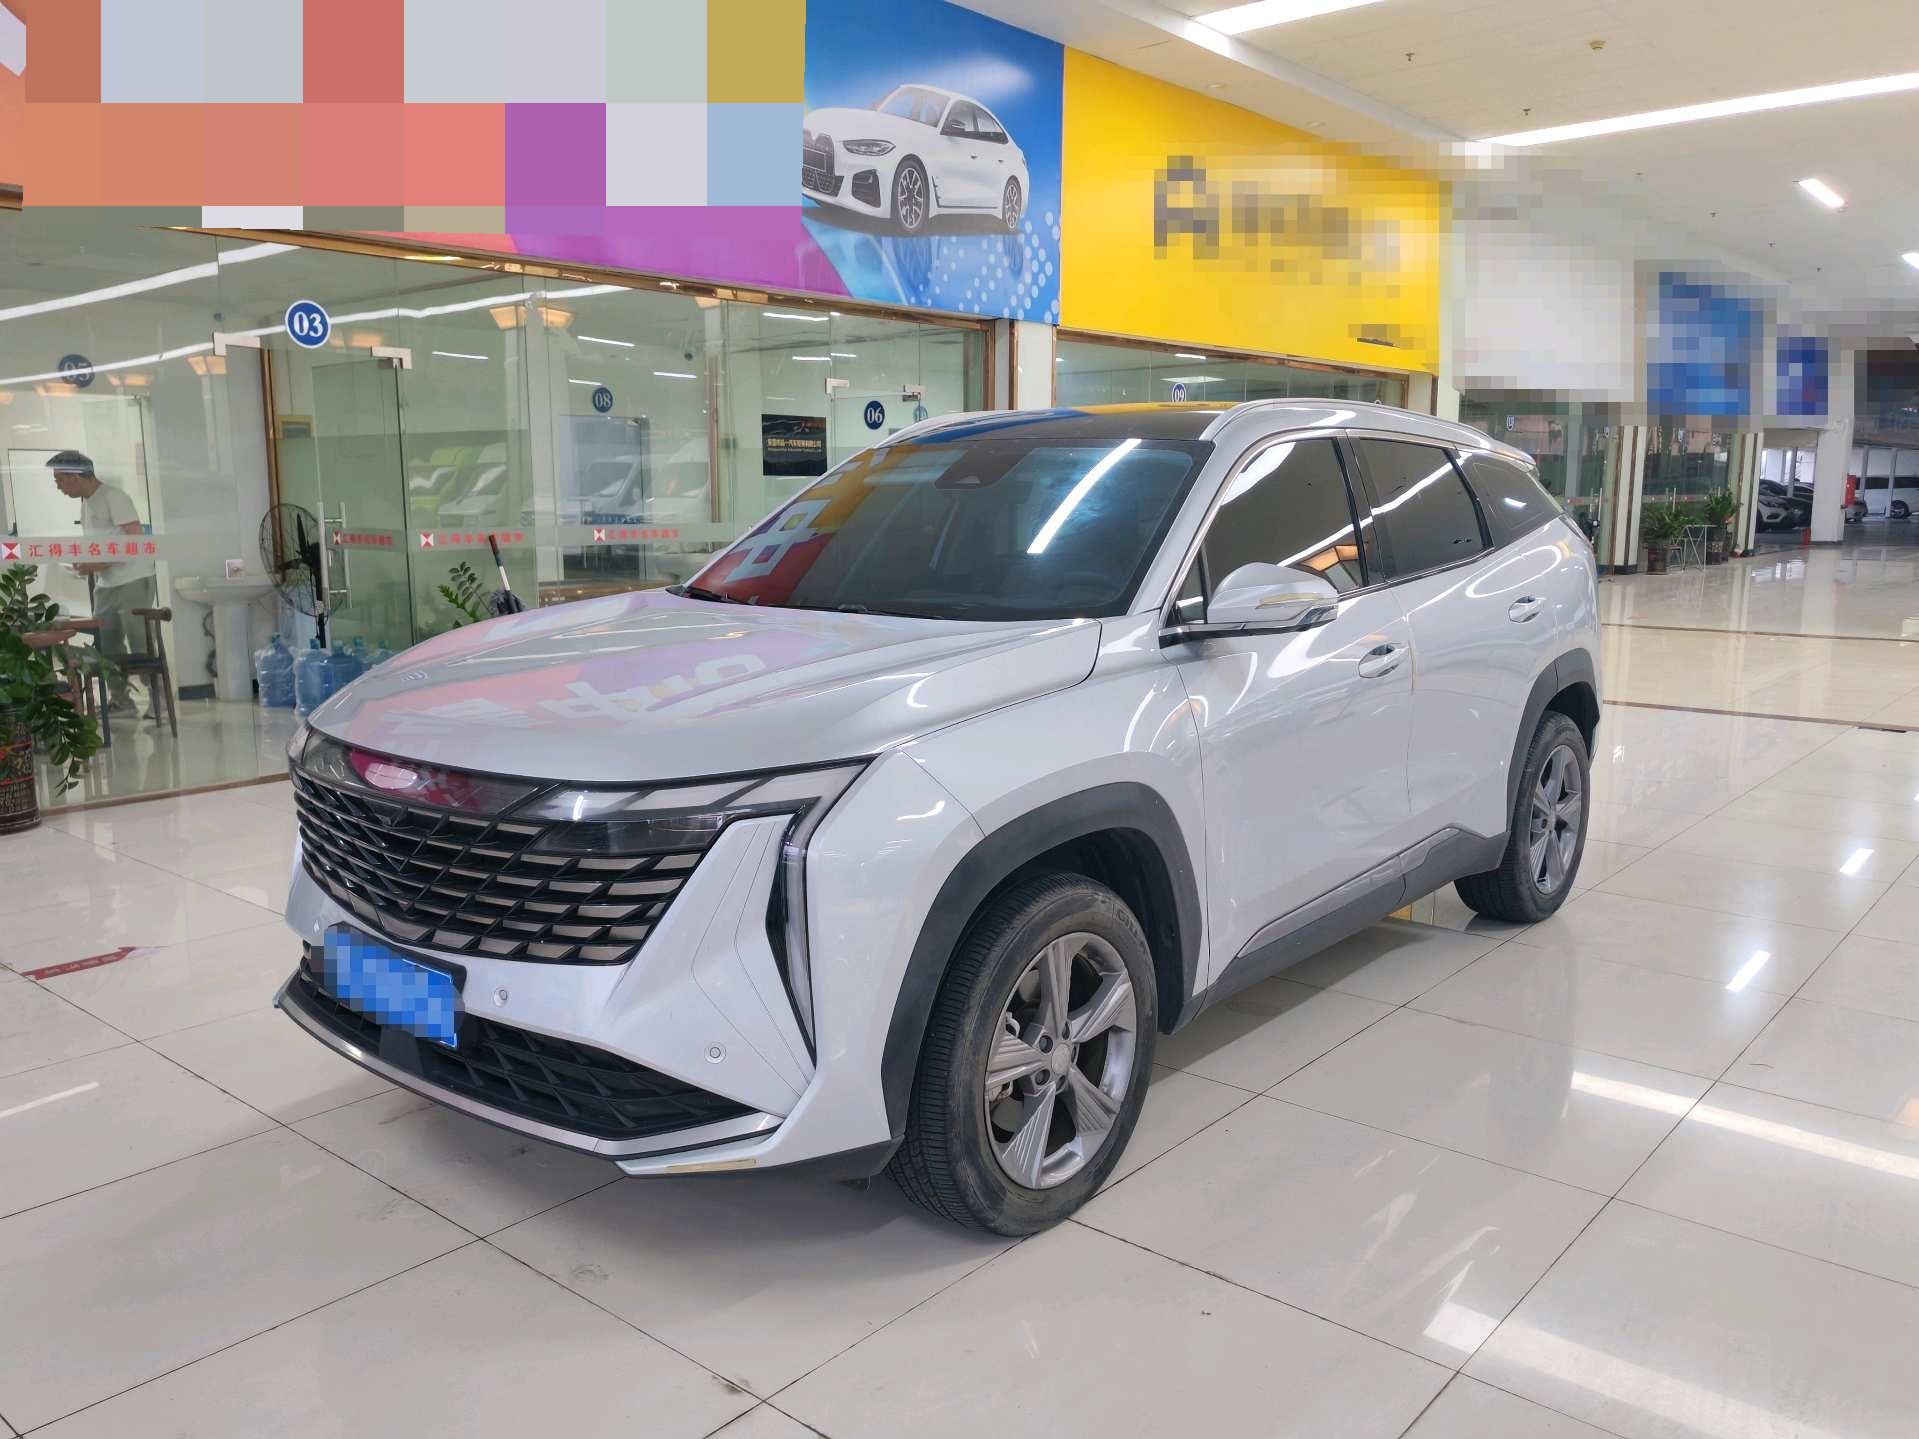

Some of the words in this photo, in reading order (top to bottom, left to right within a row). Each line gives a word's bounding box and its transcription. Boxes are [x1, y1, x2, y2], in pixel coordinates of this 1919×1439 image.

[293, 311, 324, 337] 03
[595, 392, 611, 409] 08
[867, 407, 883, 424] 06
[27, 542, 156, 558] 汇得丰名车超市
